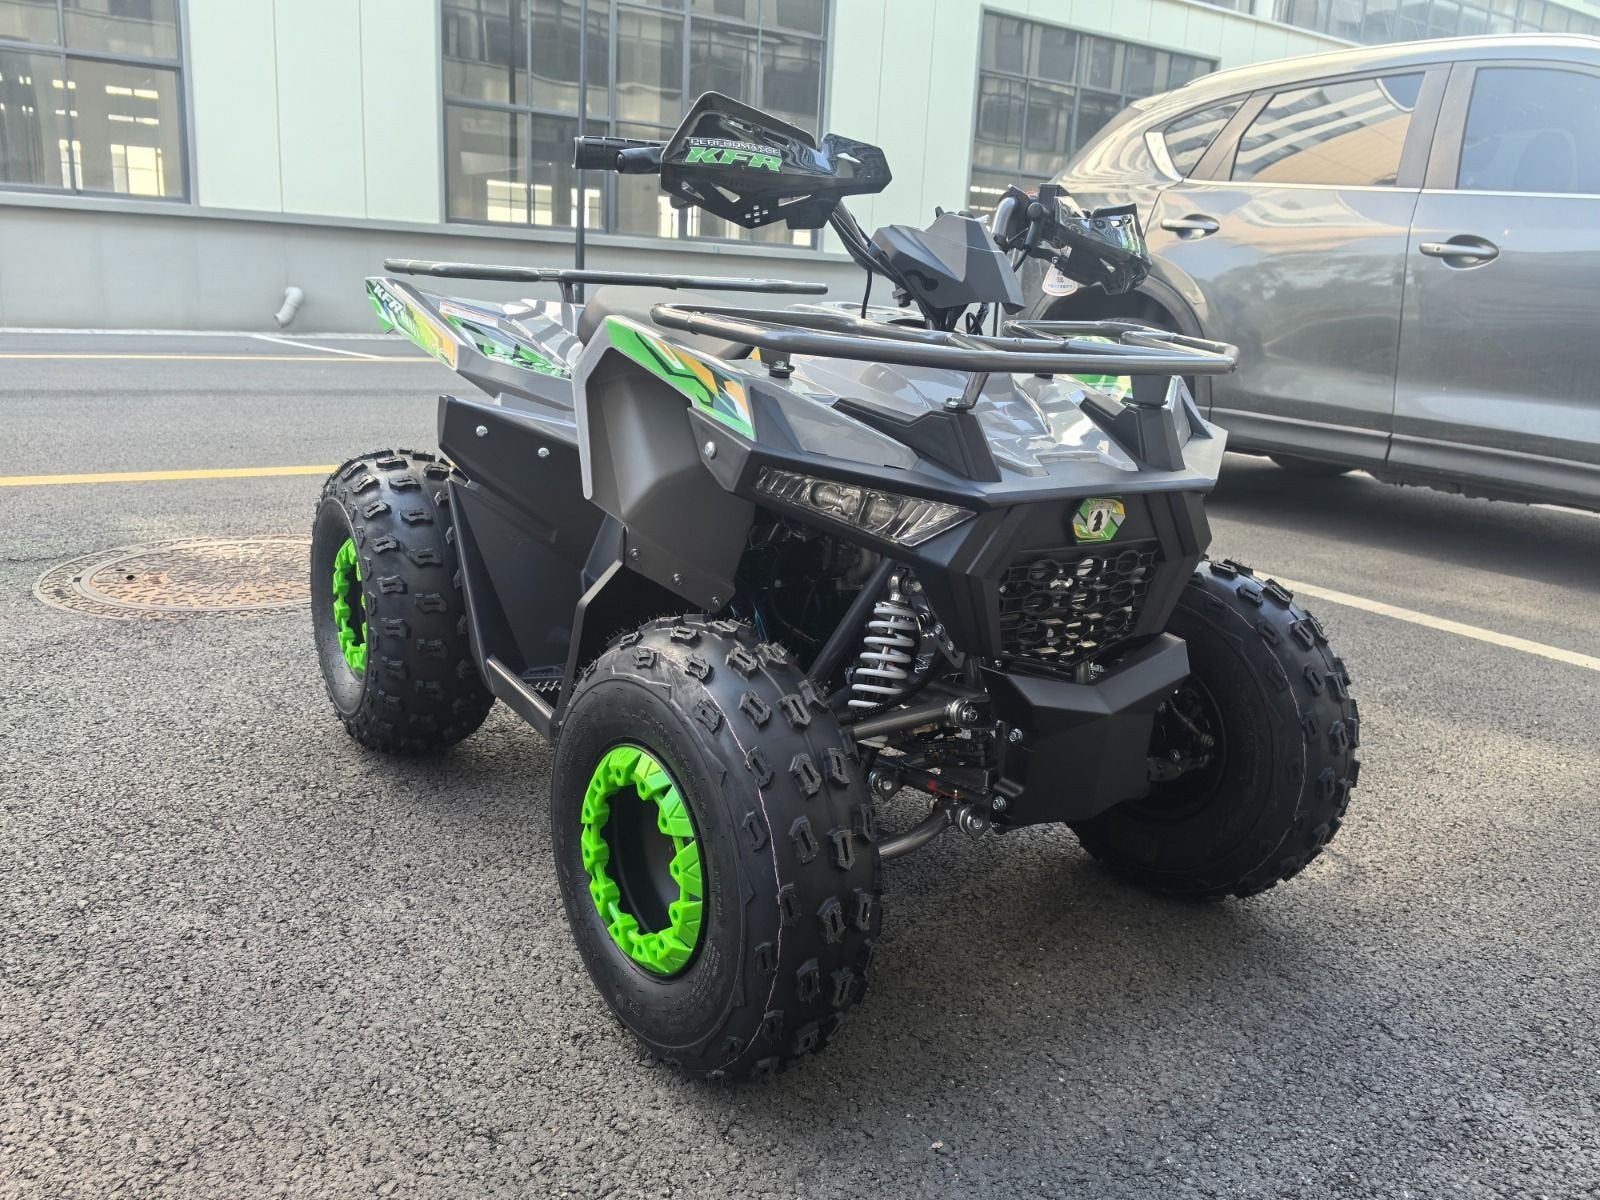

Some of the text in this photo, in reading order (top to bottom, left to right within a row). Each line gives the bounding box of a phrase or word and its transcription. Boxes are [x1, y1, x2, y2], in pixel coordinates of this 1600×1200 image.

[685, 146, 783, 172] KFR
[690, 137, 781, 155] PERFORMANCE
[373, 283, 404, 313] KFR
